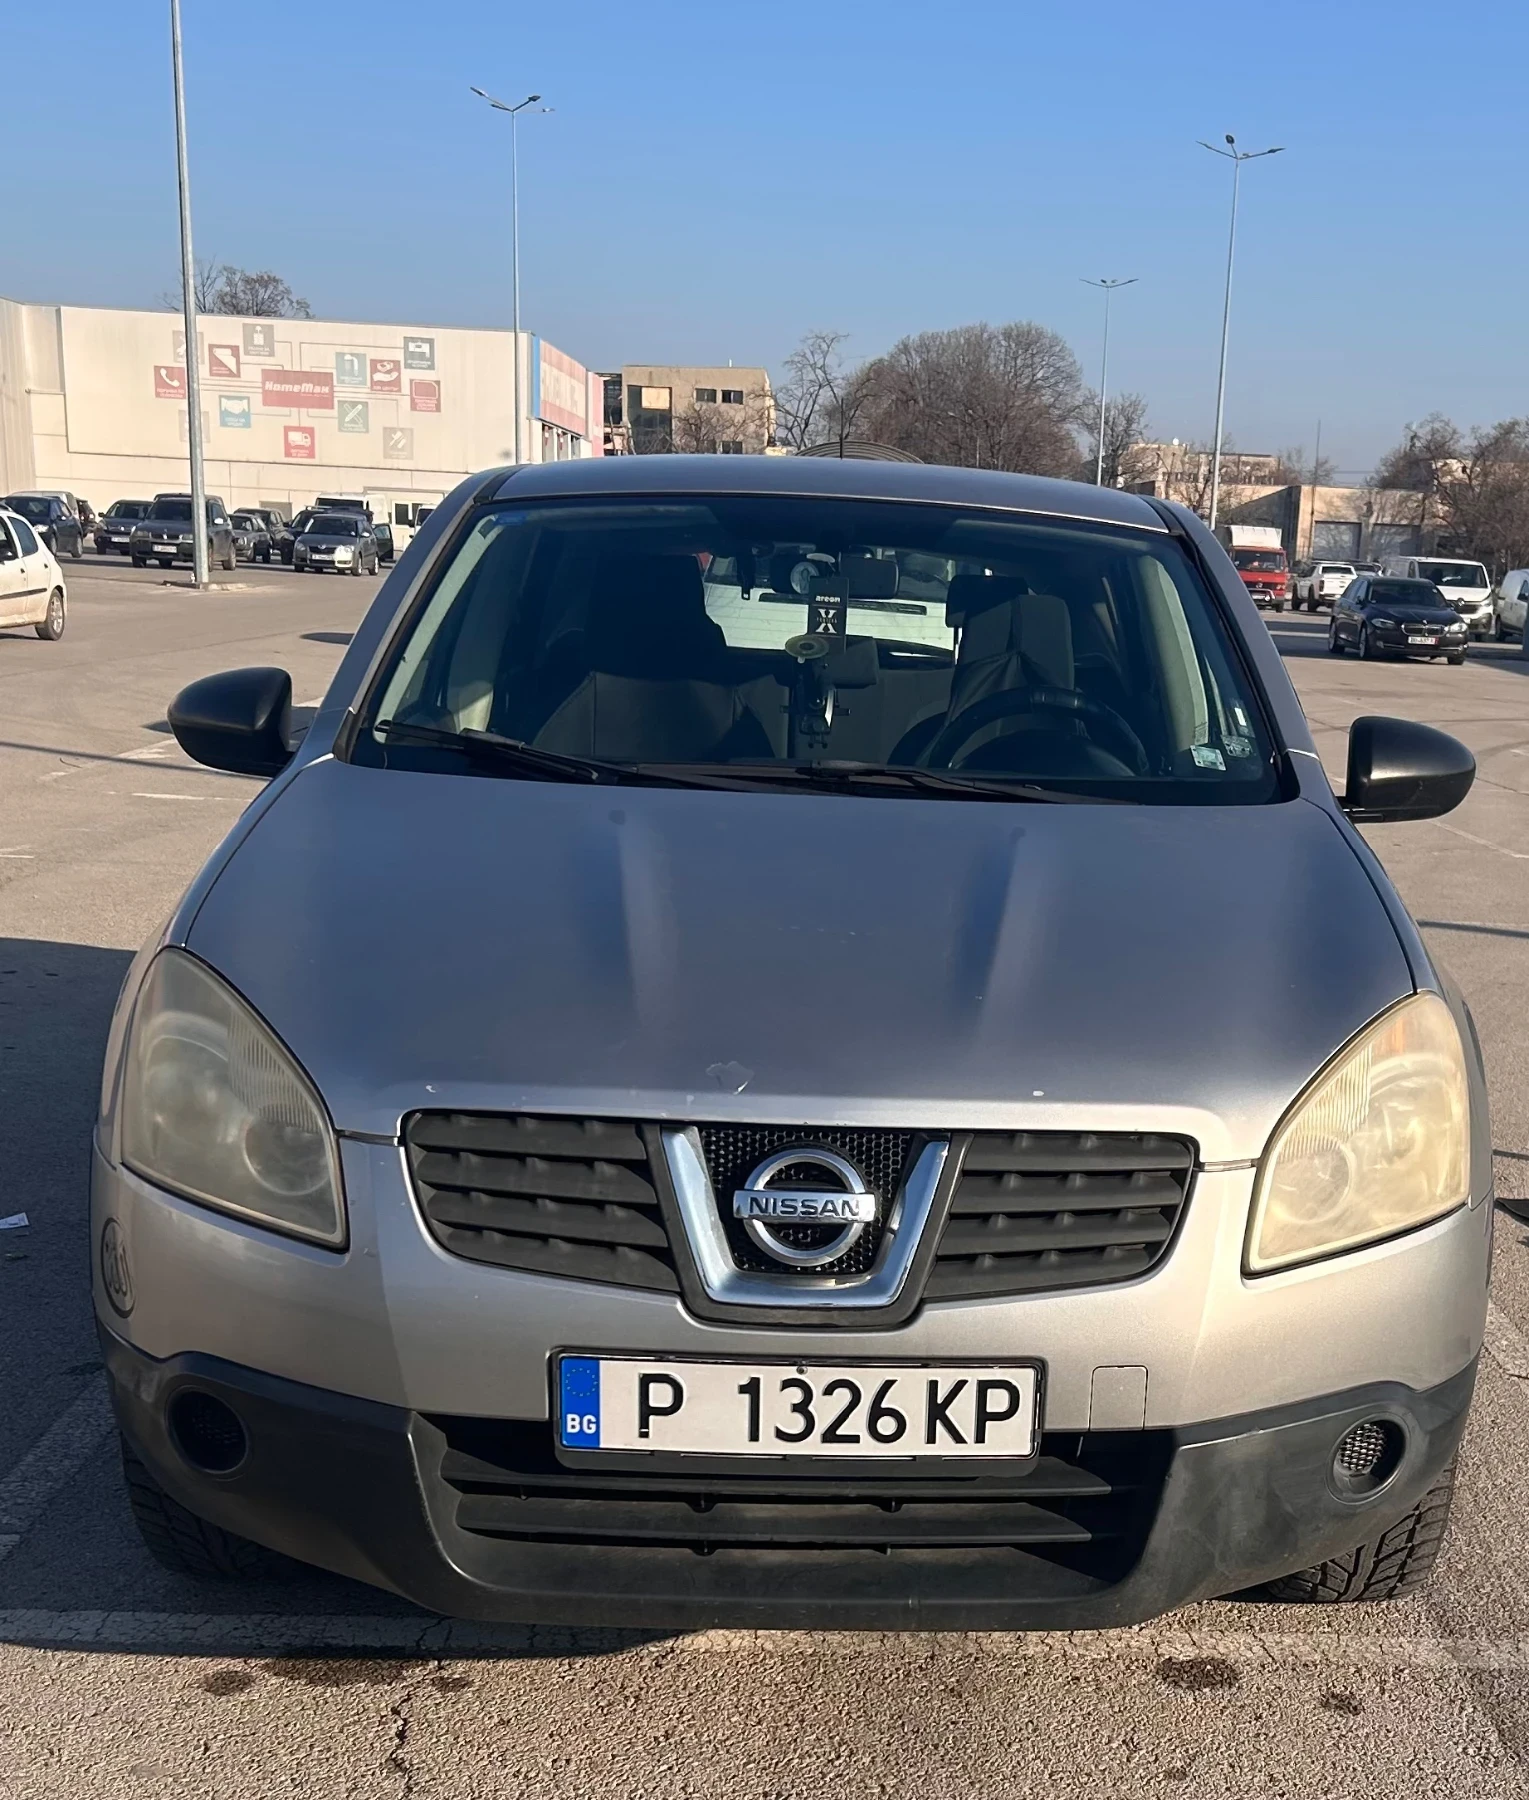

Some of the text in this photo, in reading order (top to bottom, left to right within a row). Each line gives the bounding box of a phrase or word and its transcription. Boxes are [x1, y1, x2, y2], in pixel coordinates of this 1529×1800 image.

[264, 380, 330, 394] HomeMax
[815, 595, 841, 603] areon
[749, 1196, 860, 1217] NISSAN
[638, 1372, 1021, 1446] P 1326 KP
[565, 1413, 597, 1434] BG
